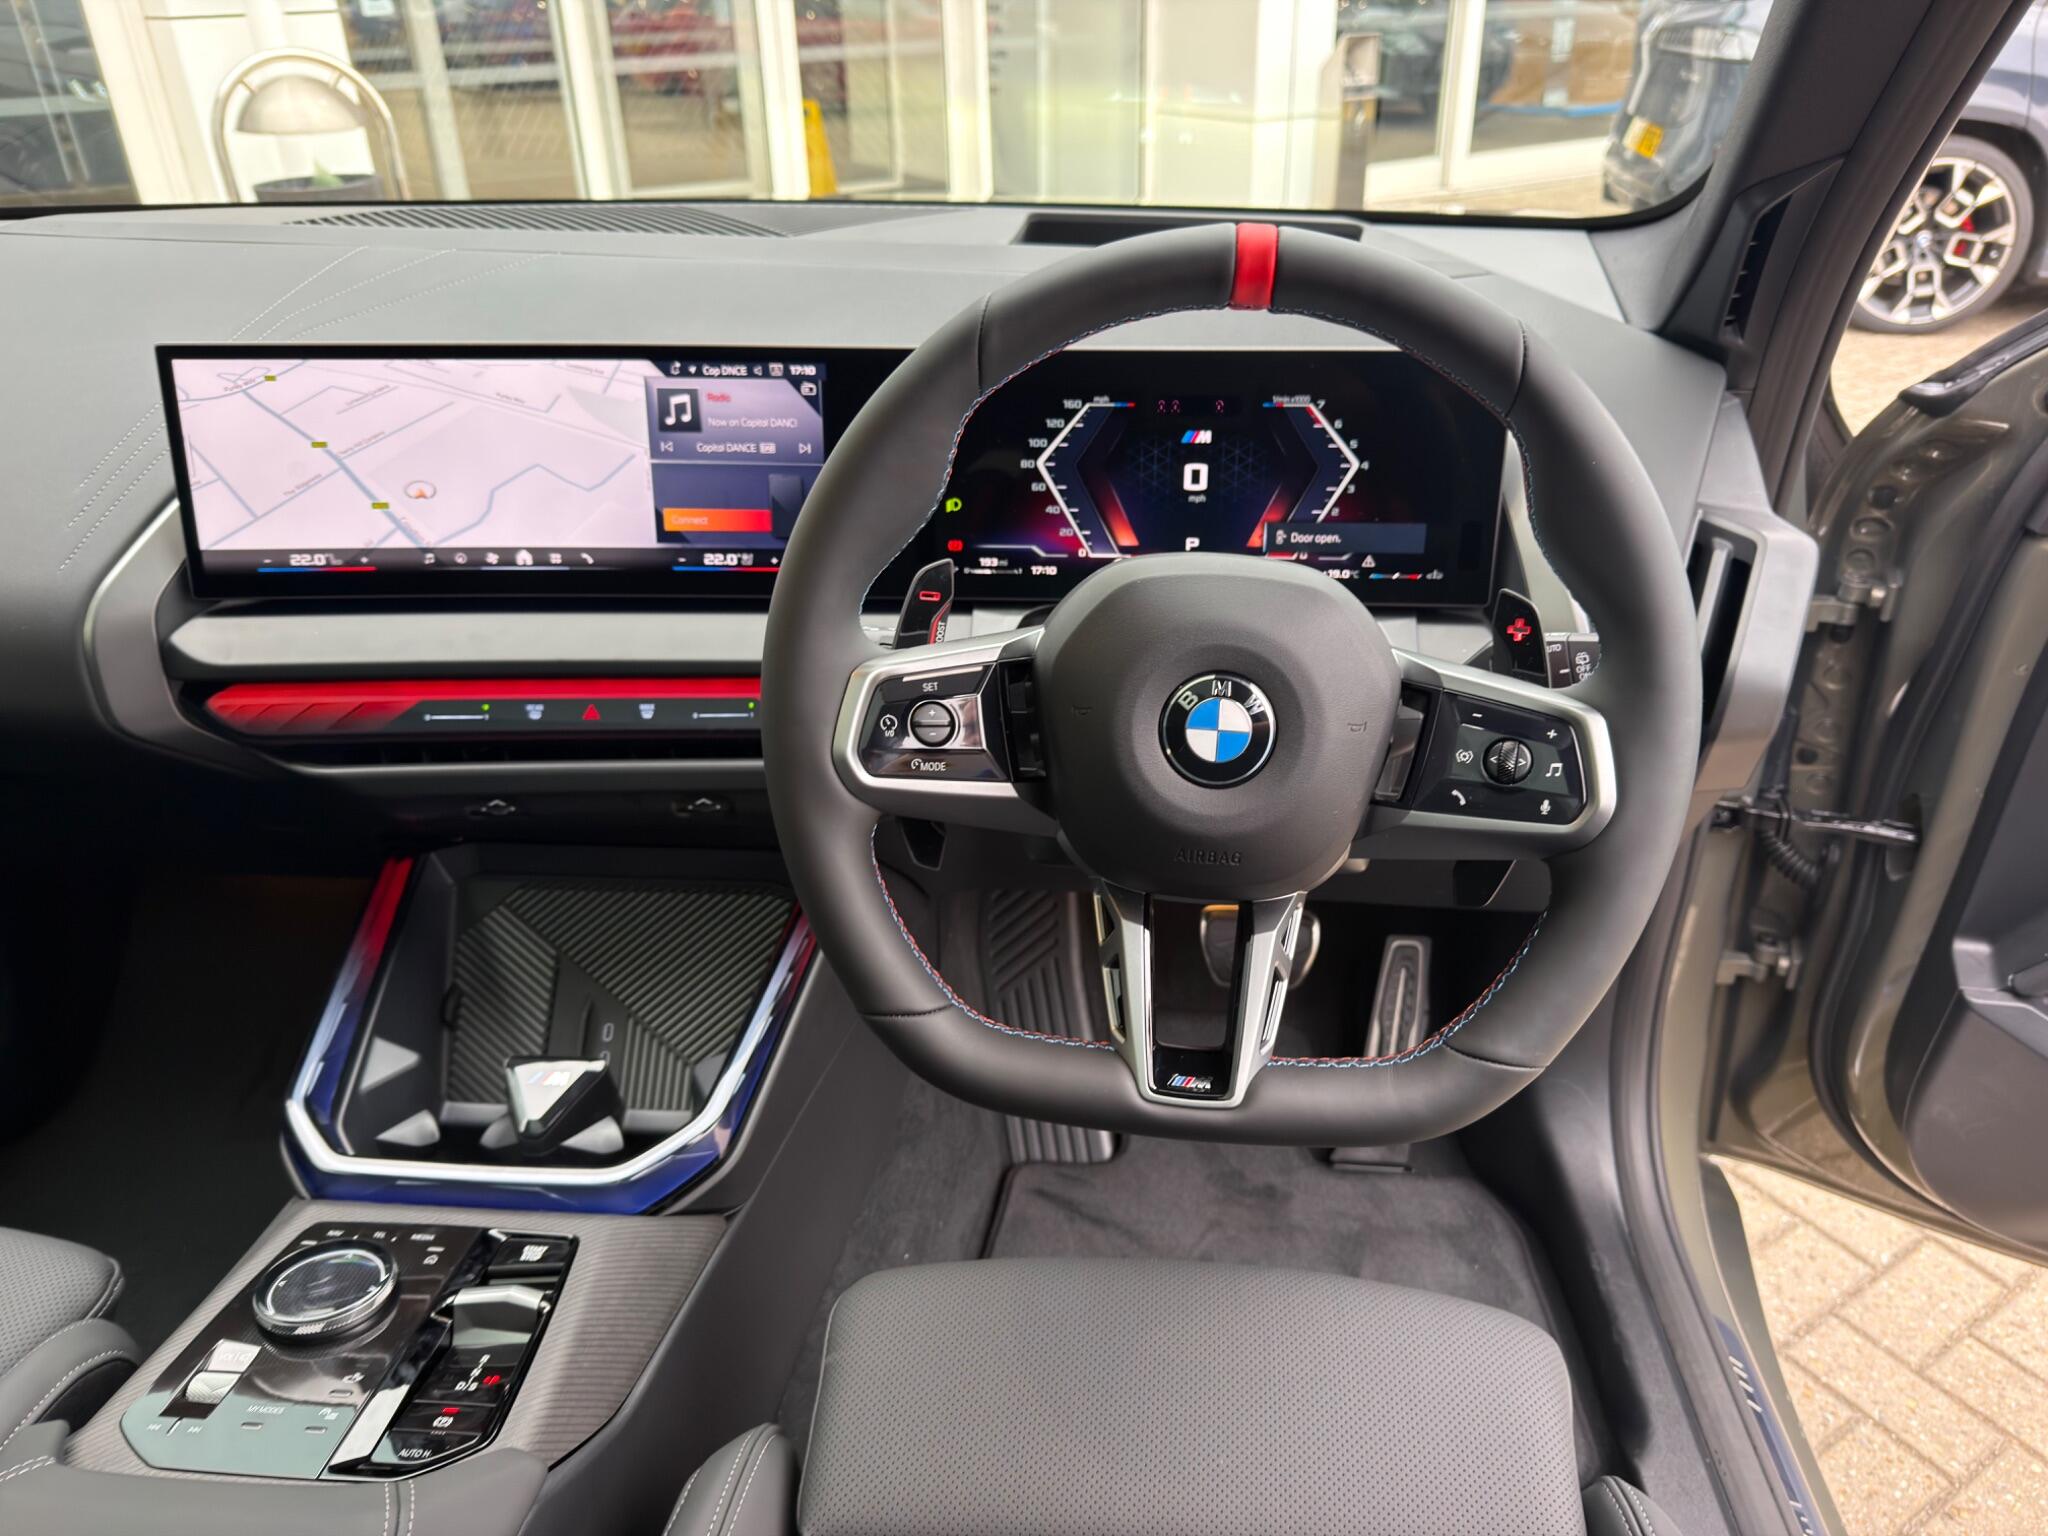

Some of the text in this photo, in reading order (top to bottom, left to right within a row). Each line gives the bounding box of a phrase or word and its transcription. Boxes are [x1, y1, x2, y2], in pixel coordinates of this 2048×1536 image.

[789, 365, 816, 375] 17:10
[1063, 400, 1082, 409] 160
[1317, 400, 1326, 409] 7
[708, 418, 726, 427] Now
[1046, 419, 1065, 428] 120
[1335, 420, 1343, 429] 6
[1028, 438, 1047, 448] 100
[1350, 440, 1358, 449] 5
[726, 443, 757, 453] DANCE
[1020, 459, 1035, 469] 80
[1361, 461, 1369, 470] 4
[1183, 463, 1209, 491] 0
[1031, 482, 1046, 492] 60
[1347, 485, 1355, 494] 3
[1188, 494, 1206, 503] mph
[1045, 505, 1060, 515] 40
[1331, 508, 1339, 516] 2
[1059, 528, 1073, 537] 20
[1290, 532, 1341, 546] Door open.
[1185, 537, 1200, 551] P
[1078, 548, 1087, 558] 0
[1031, 566, 1058, 575] 17:10
[936, 622, 946, 642] OOST
[1546, 644, 1562, 653] UTO
[922, 682, 938, 692] SET
[1178, 680, 1265, 715] BMW
[920, 762, 946, 771] MODE
[1174, 848, 1242, 866] AIRBAG
[410, 1233, 436, 1241] MEDIA
[398, 1448, 423, 1458] AUTO
